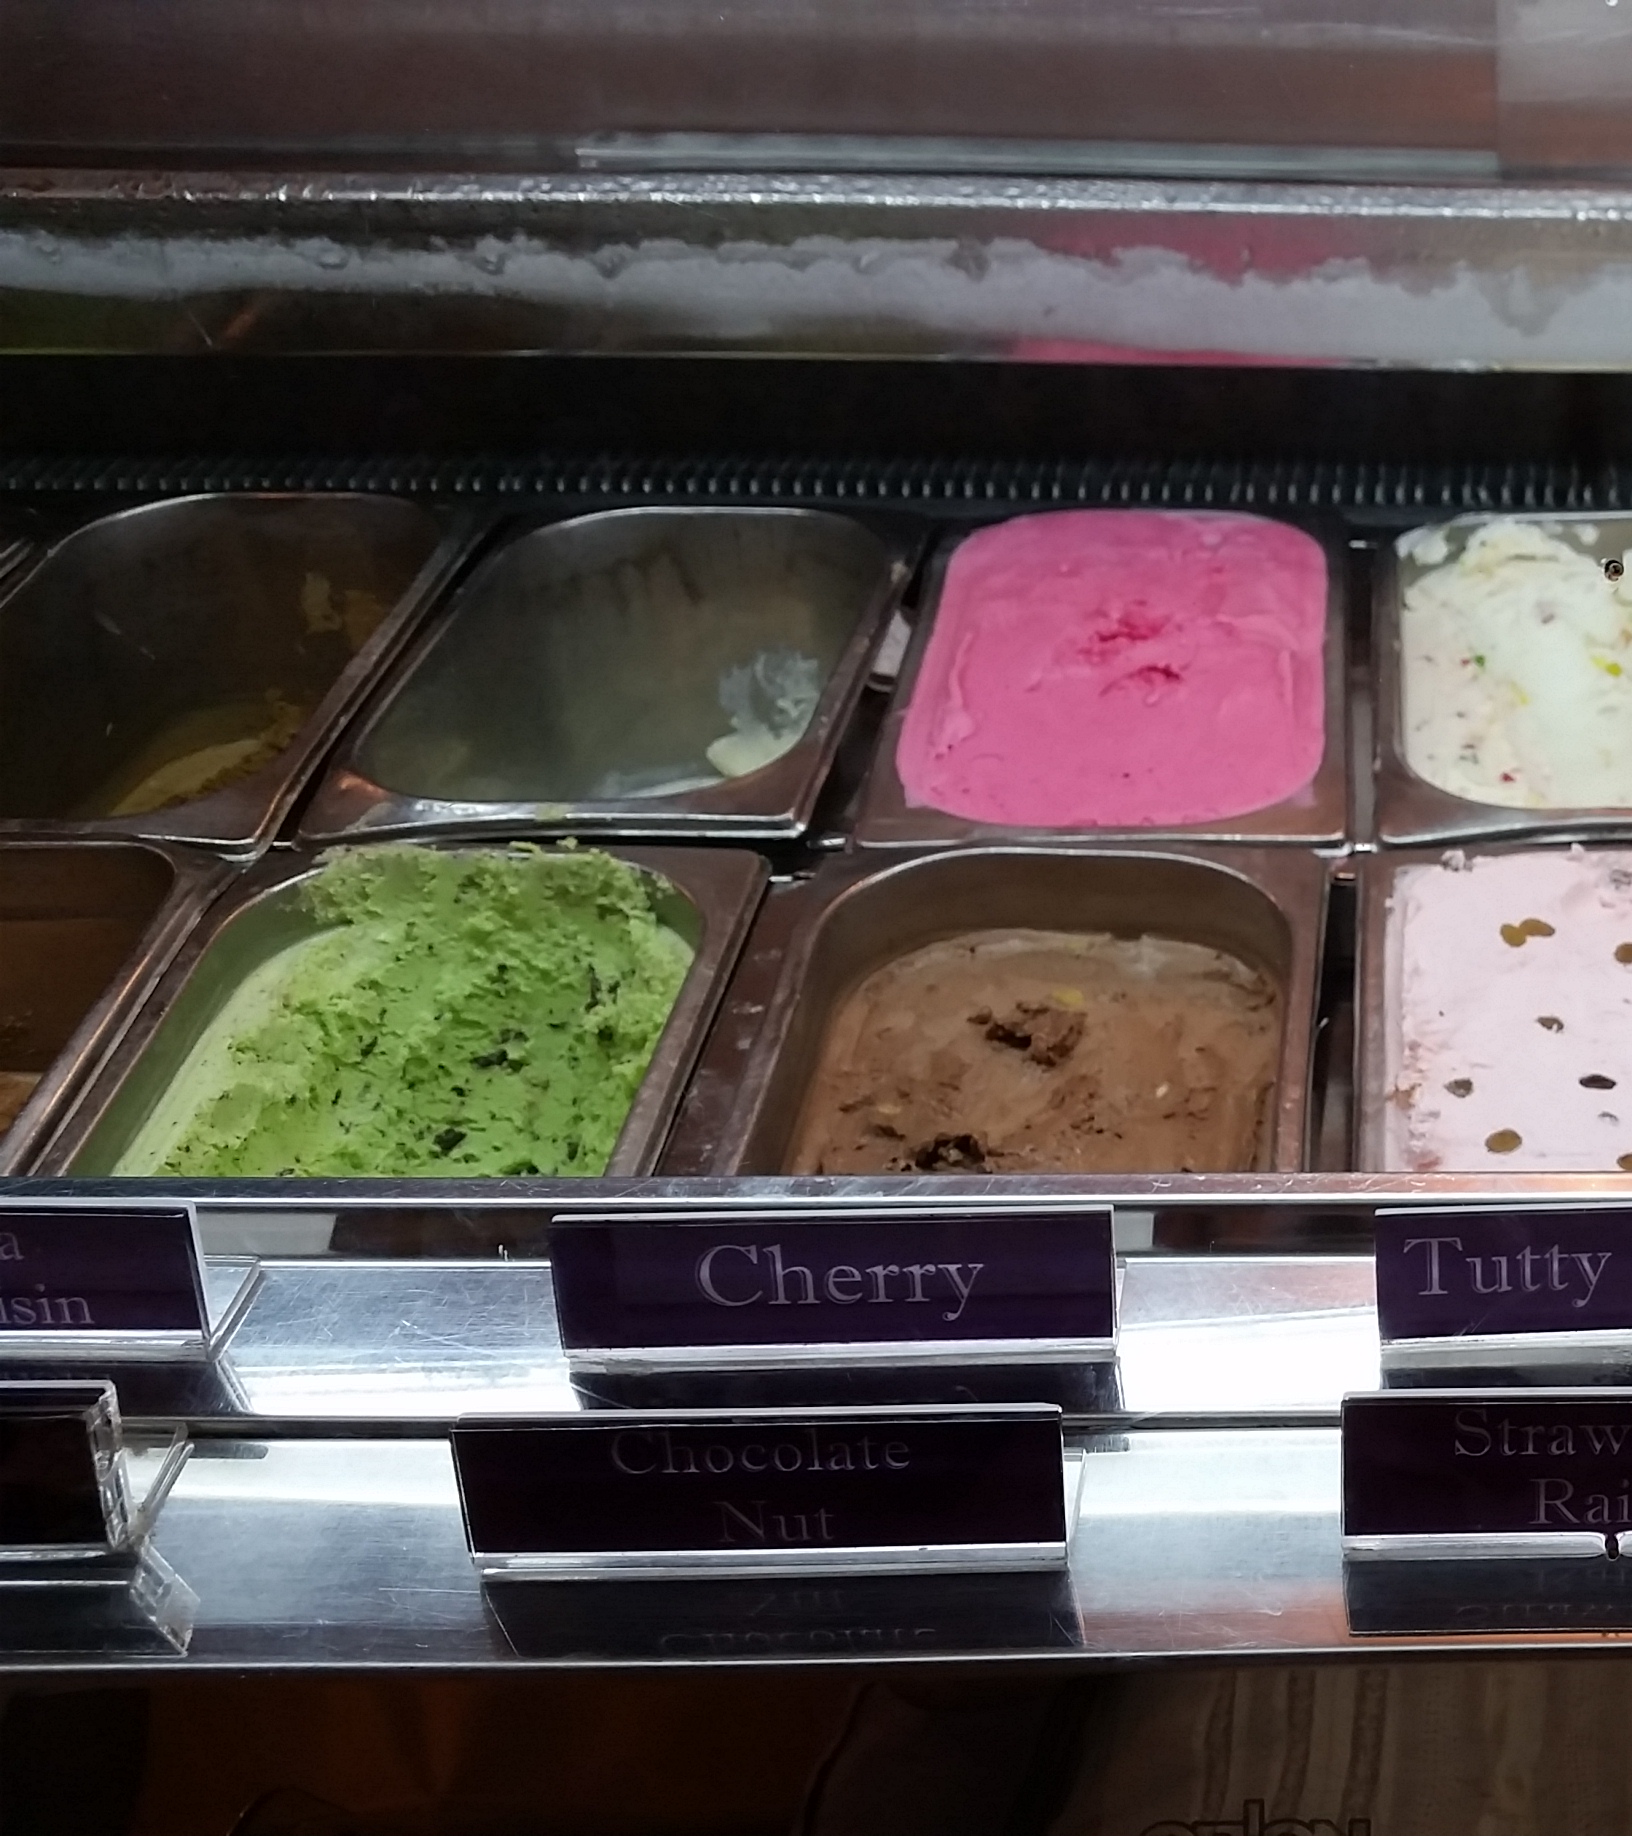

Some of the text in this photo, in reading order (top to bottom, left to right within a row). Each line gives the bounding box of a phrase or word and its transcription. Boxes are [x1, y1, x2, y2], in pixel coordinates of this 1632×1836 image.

[696, 1242, 984, 1322] Cherry
[1403, 1236, 1612, 1308] Tutty
[609, 1426, 912, 1475] Chocolate
[715, 1499, 834, 1543] Nut
